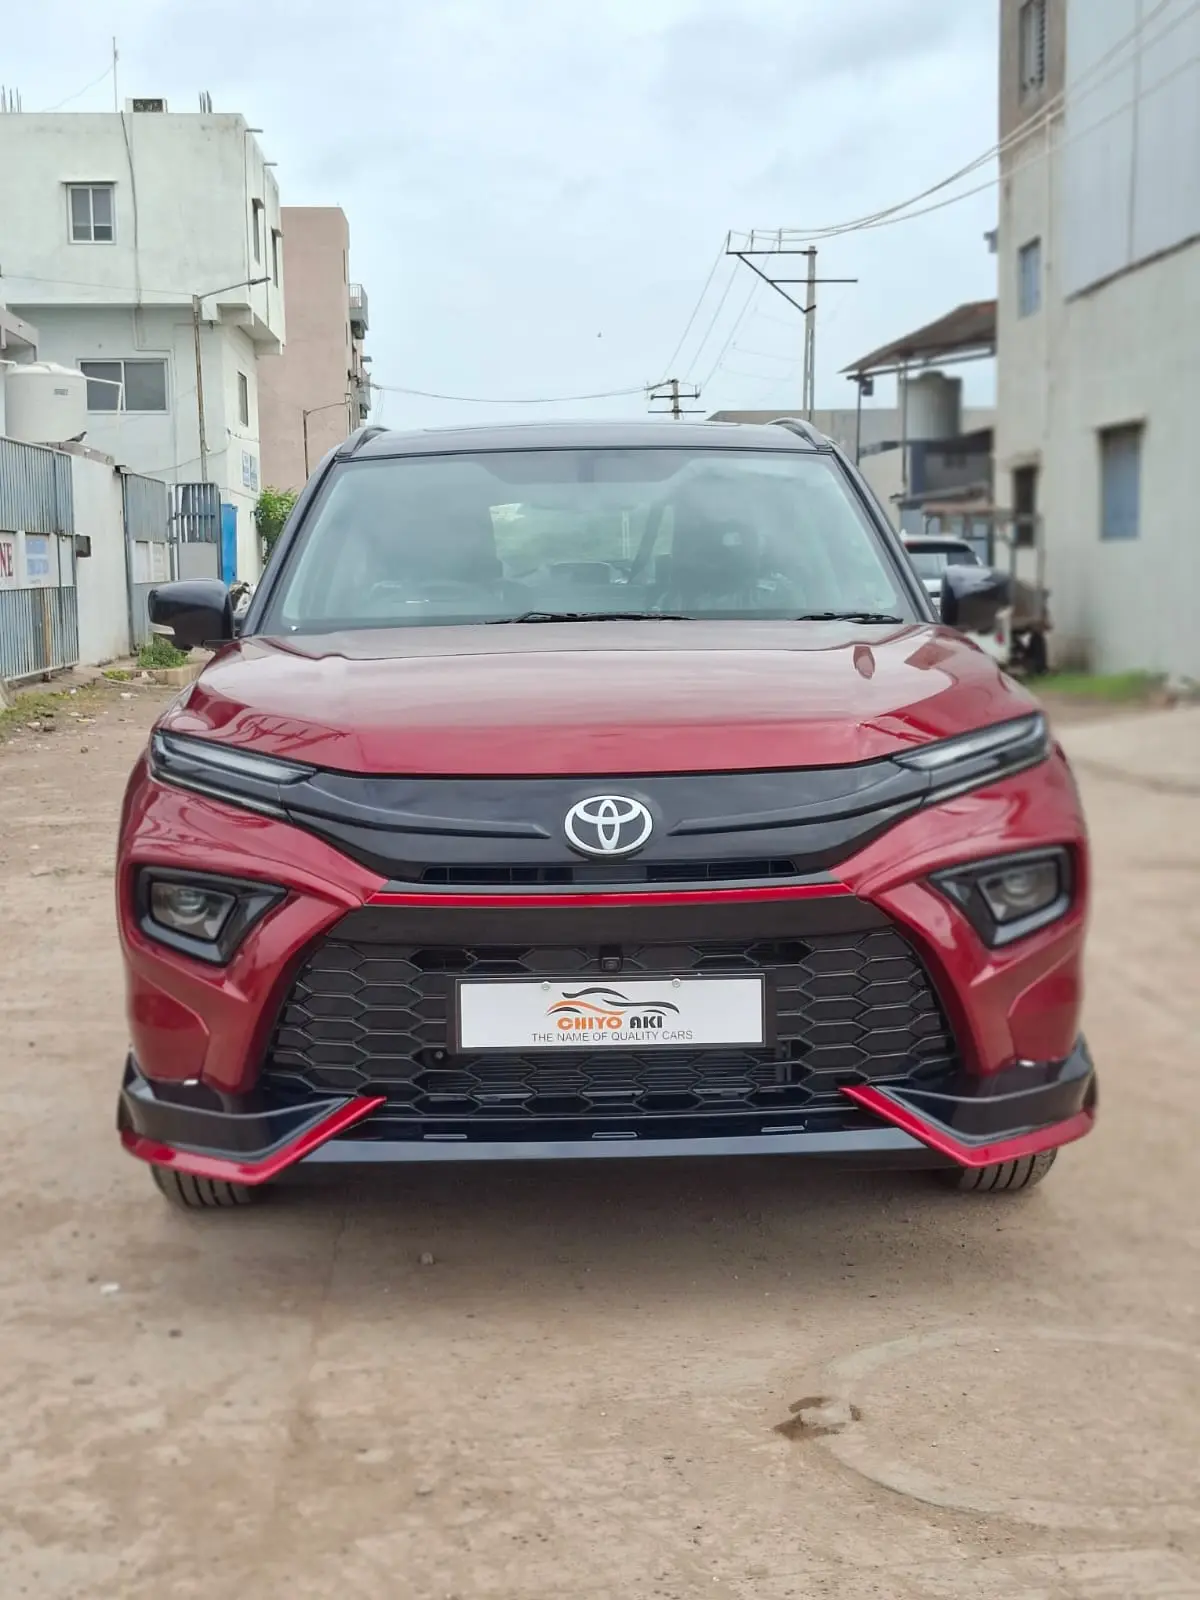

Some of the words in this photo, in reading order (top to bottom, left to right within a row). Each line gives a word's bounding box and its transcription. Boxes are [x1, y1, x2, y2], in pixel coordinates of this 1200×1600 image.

[557, 1016, 622, 1030] CHIYO
[630, 1016, 663, 1029] AKI
[531, 1032, 553, 1042] THE
[557, 1032, 589, 1042] NAME
[592, 1032, 608, 1041] OF
[611, 1031, 659, 1041] QUALITY
[662, 1030, 693, 1040] CARS
